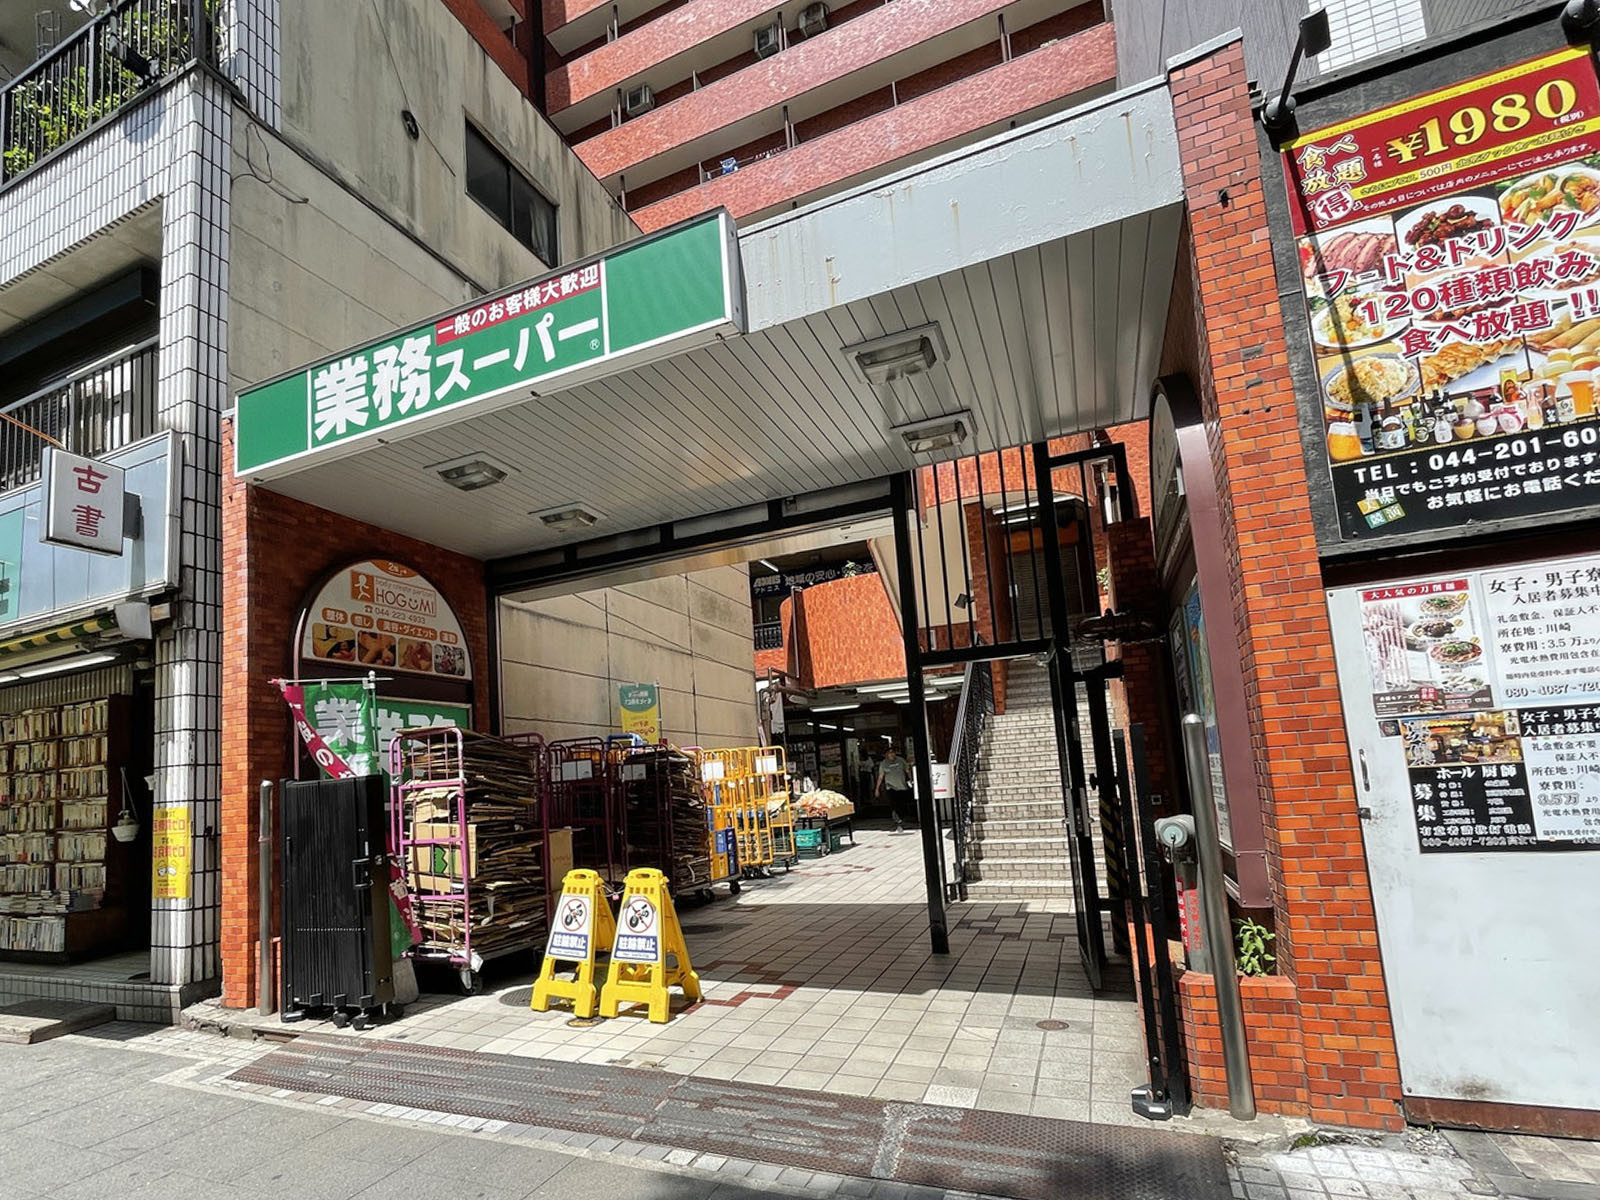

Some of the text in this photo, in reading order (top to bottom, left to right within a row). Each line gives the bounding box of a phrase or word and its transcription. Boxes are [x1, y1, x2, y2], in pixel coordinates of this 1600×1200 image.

[1386, 80, 1576, 165] ¥1980
[1297, 134, 1359, 171] 食べ
[1301, 156, 1367, 195] 放題
[1420, 163, 1453, 179] 500円
[1317, 190, 1349, 219] 得
[437, 264, 600, 338] 一般のお客様大歓迎
[1362, 251, 1592, 324] 120種類飲み
[314, 312, 600, 441] 業務スーパー
[1354, 463, 1399, 484] TEL
[1429, 427, 1600, 471] 044-201-60
[1365, 452, 1600, 501] 当日でもご予約受付でおります
[73, 465, 109, 537] 古書
[1436, 766, 1475, 779] ホール
[1413, 783, 1437, 821] 募集
